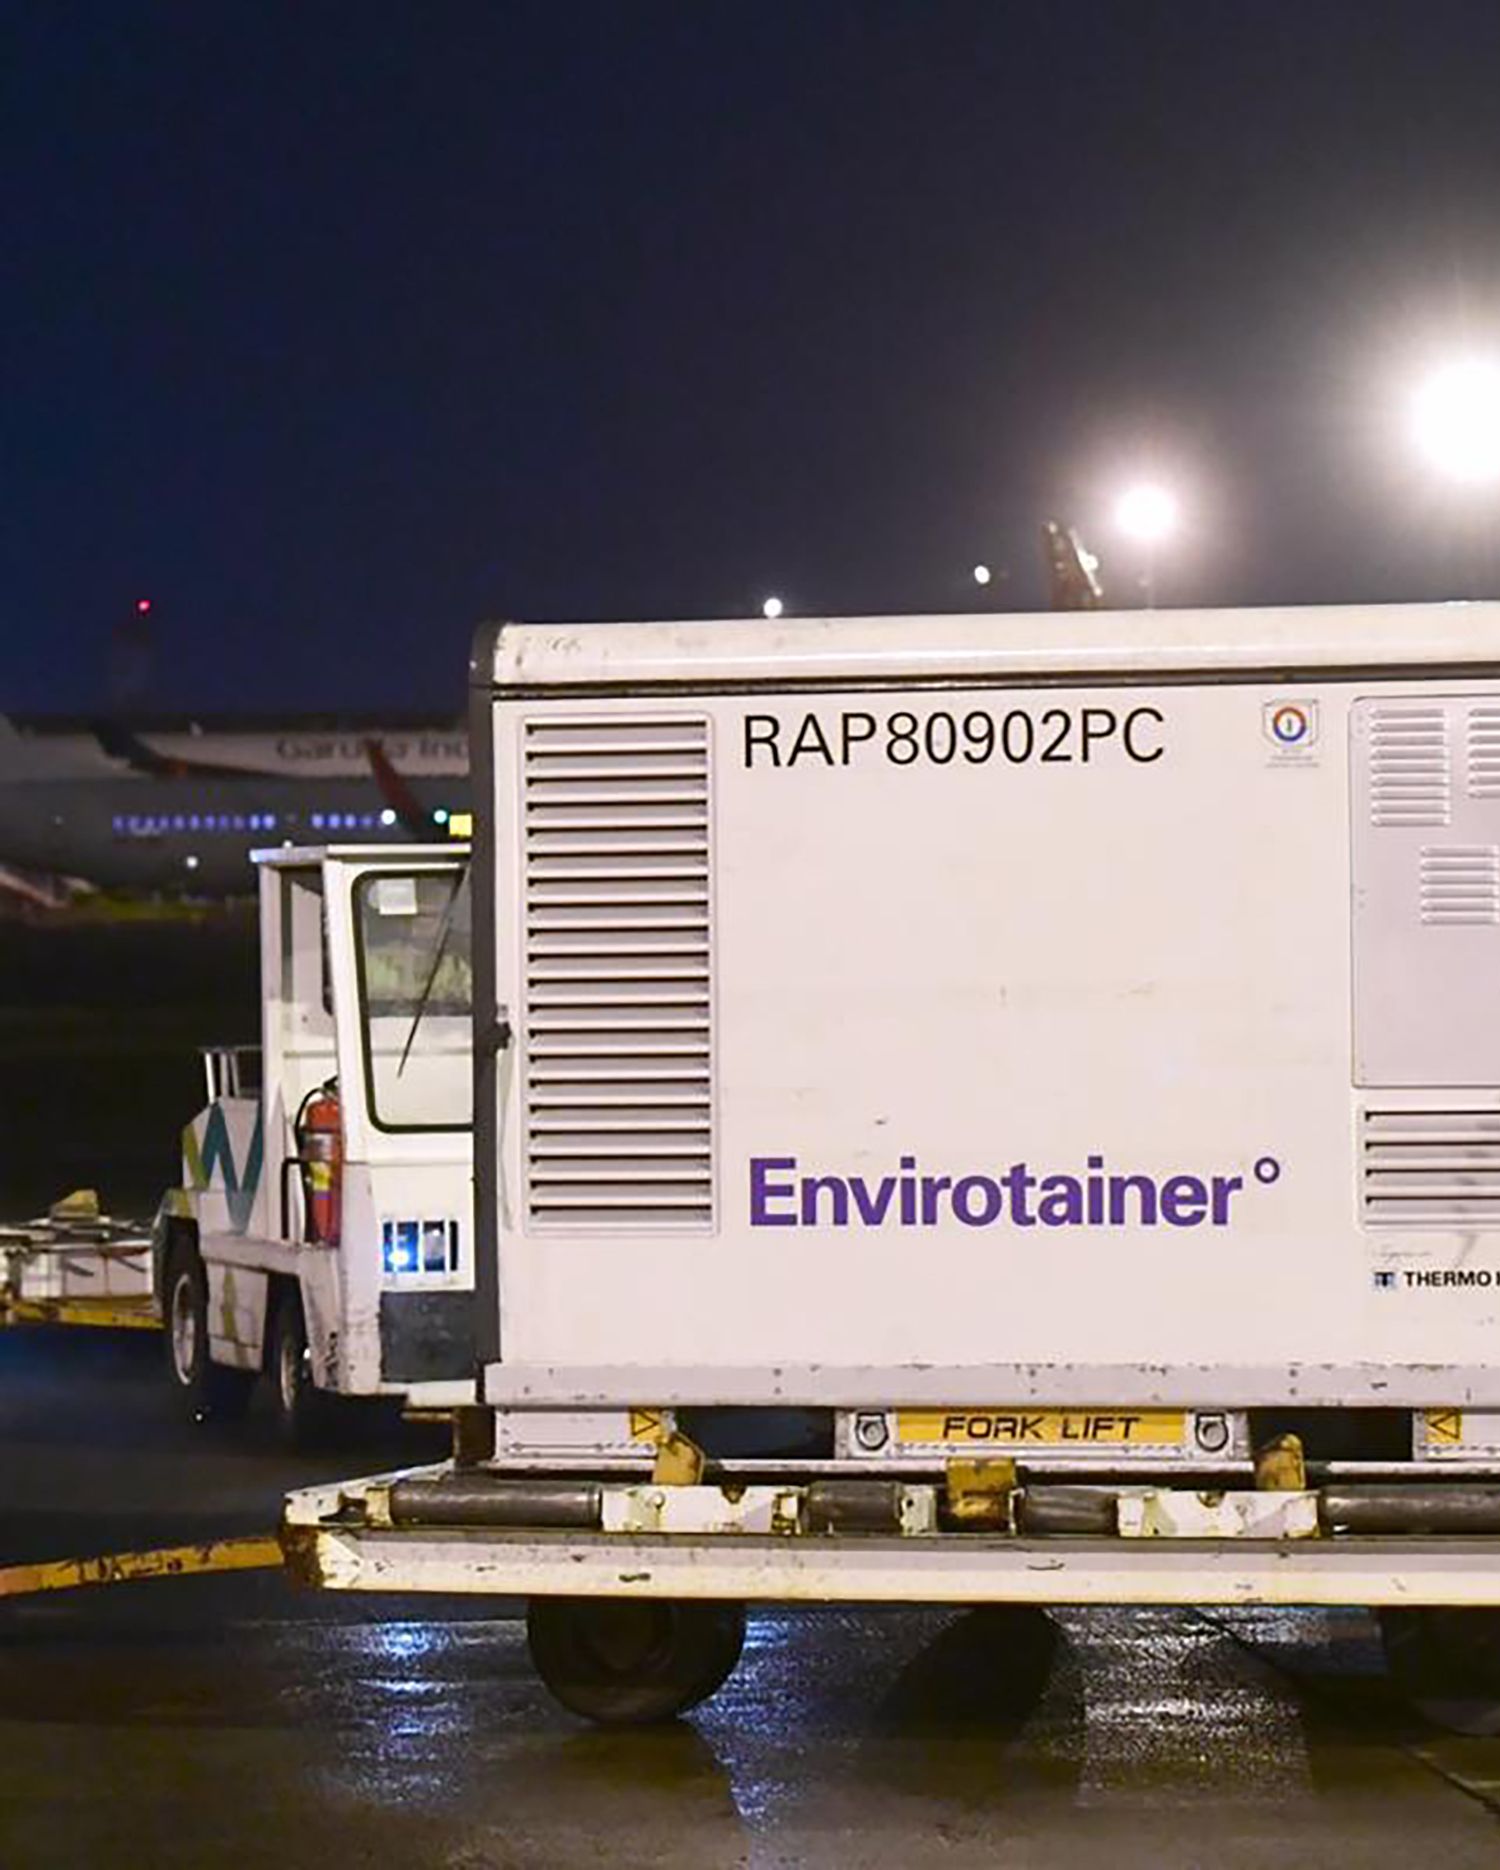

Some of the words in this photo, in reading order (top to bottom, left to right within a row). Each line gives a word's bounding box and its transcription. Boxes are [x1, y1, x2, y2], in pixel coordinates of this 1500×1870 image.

[744, 707, 1164, 769] RAP80902PC
[1404, 1270, 1492, 1288] THERMO
[942, 1415, 1043, 1440] FORK
[1061, 1415, 1141, 1440] LIFT
